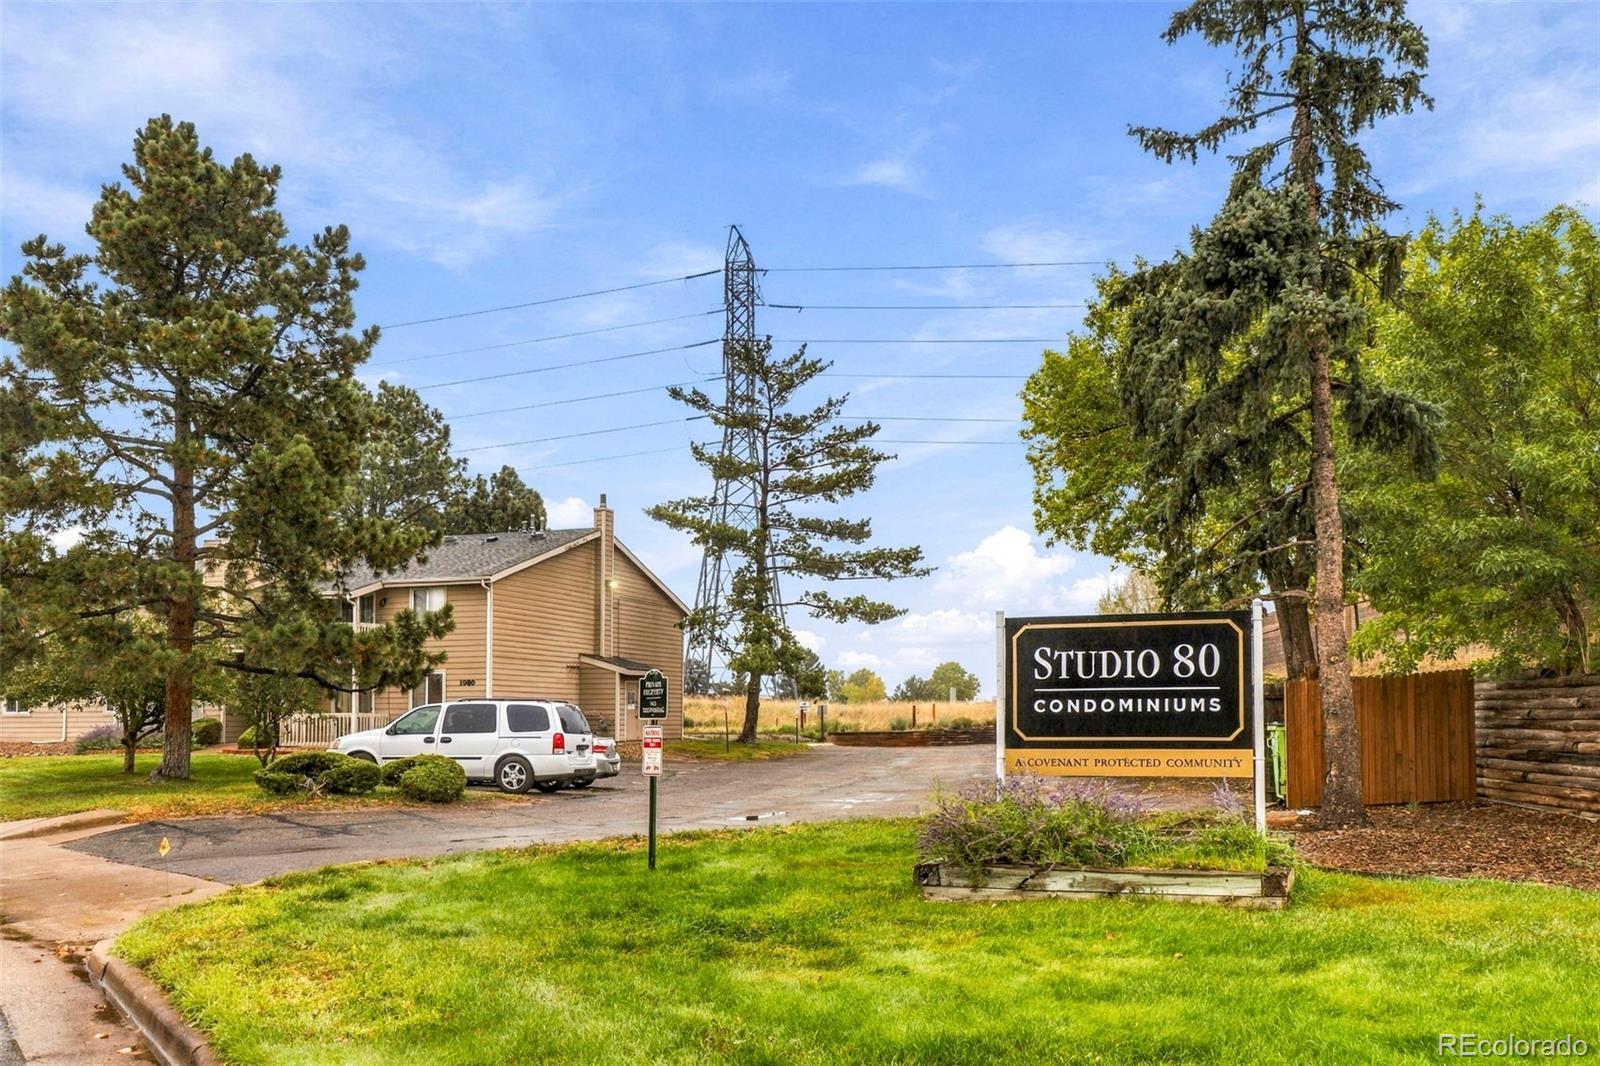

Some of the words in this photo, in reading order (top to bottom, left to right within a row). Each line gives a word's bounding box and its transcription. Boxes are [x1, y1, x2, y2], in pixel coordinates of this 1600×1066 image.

[1034, 646, 1161, 680] STUDIO
[1173, 643, 1221, 678] 80
[1034, 698, 1222, 713] CONDOMINIUMS
[1015, 758, 1023, 767] A
[1027, 758, 1089, 767] COVENANT
[1094, 758, 1161, 768] PROTECTED
[1166, 758, 1243, 768] COMMUNITY
